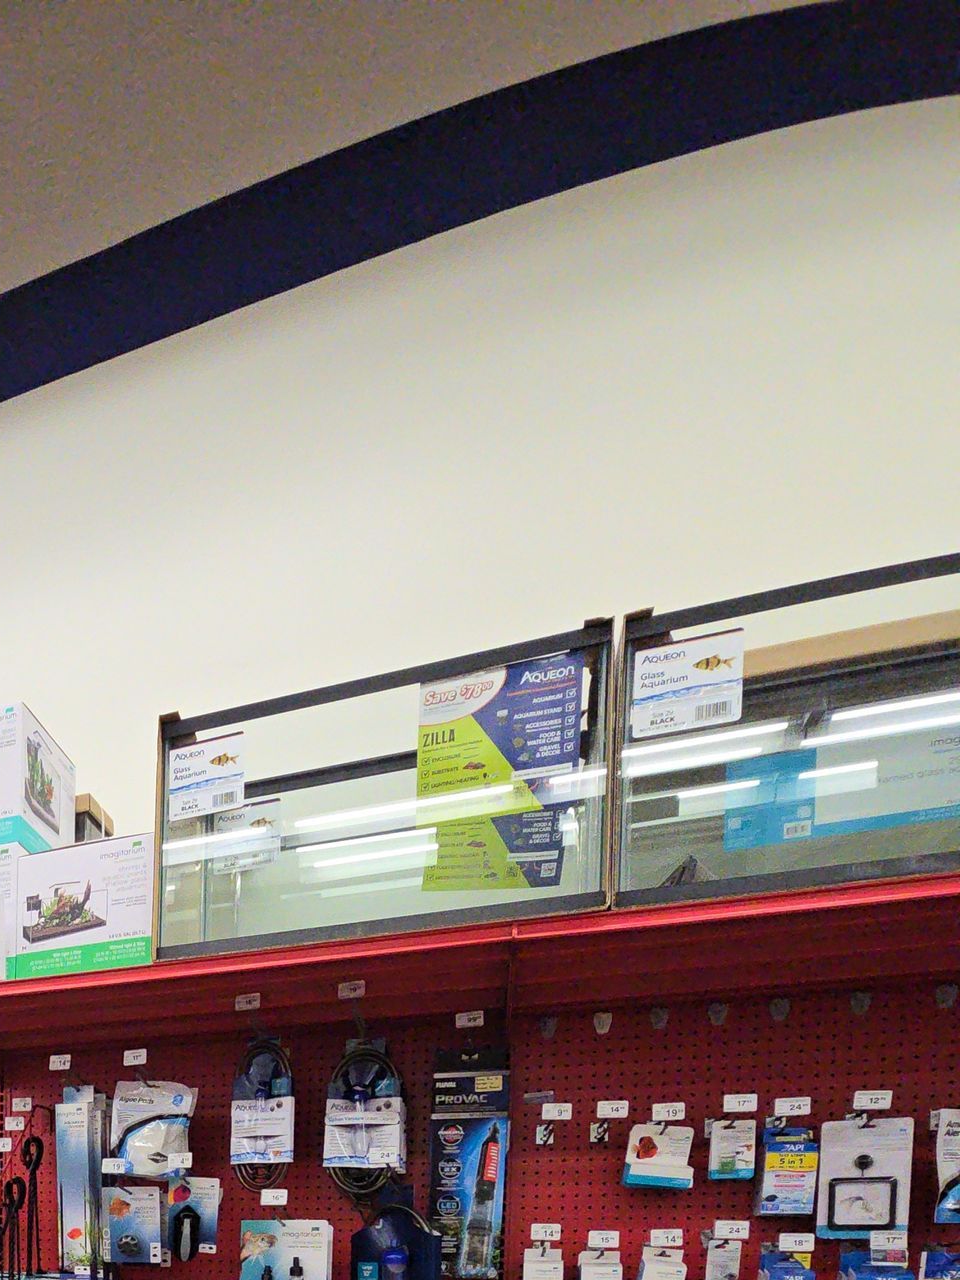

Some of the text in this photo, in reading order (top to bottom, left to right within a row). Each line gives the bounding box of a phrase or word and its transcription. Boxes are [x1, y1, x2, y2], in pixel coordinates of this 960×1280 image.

[640, 671, 665, 681] Glass
[640, 674, 689, 689] Aquarium
[424, 690, 457, 706] Save
[513, 707, 562, 720] AQUARIUM STAND
[525, 717, 562, 729] ACCESSORIES
[649, 716, 675, 726] BLACK
[423, 728, 455, 747] ZILLA
[527, 738, 546, 746] WATER
[173, 765, 191, 775] Glass
[173, 769, 207, 782] Aquarium
[181, 804, 199, 812] BLACK
[100, 847, 145, 860] imagitarium
[118, 1096, 137, 1104] Algae
[666, 1109, 684, 1117] 19
[380, 1151, 396, 1159] 24
[441, 1201, 457, 1209] LED
[282, 1230, 323, 1240] imagitarium
[728, 1226, 746, 1234] 24
[103, 1227, 111, 1261] PRO
[665, 1235, 682, 1243] 14
